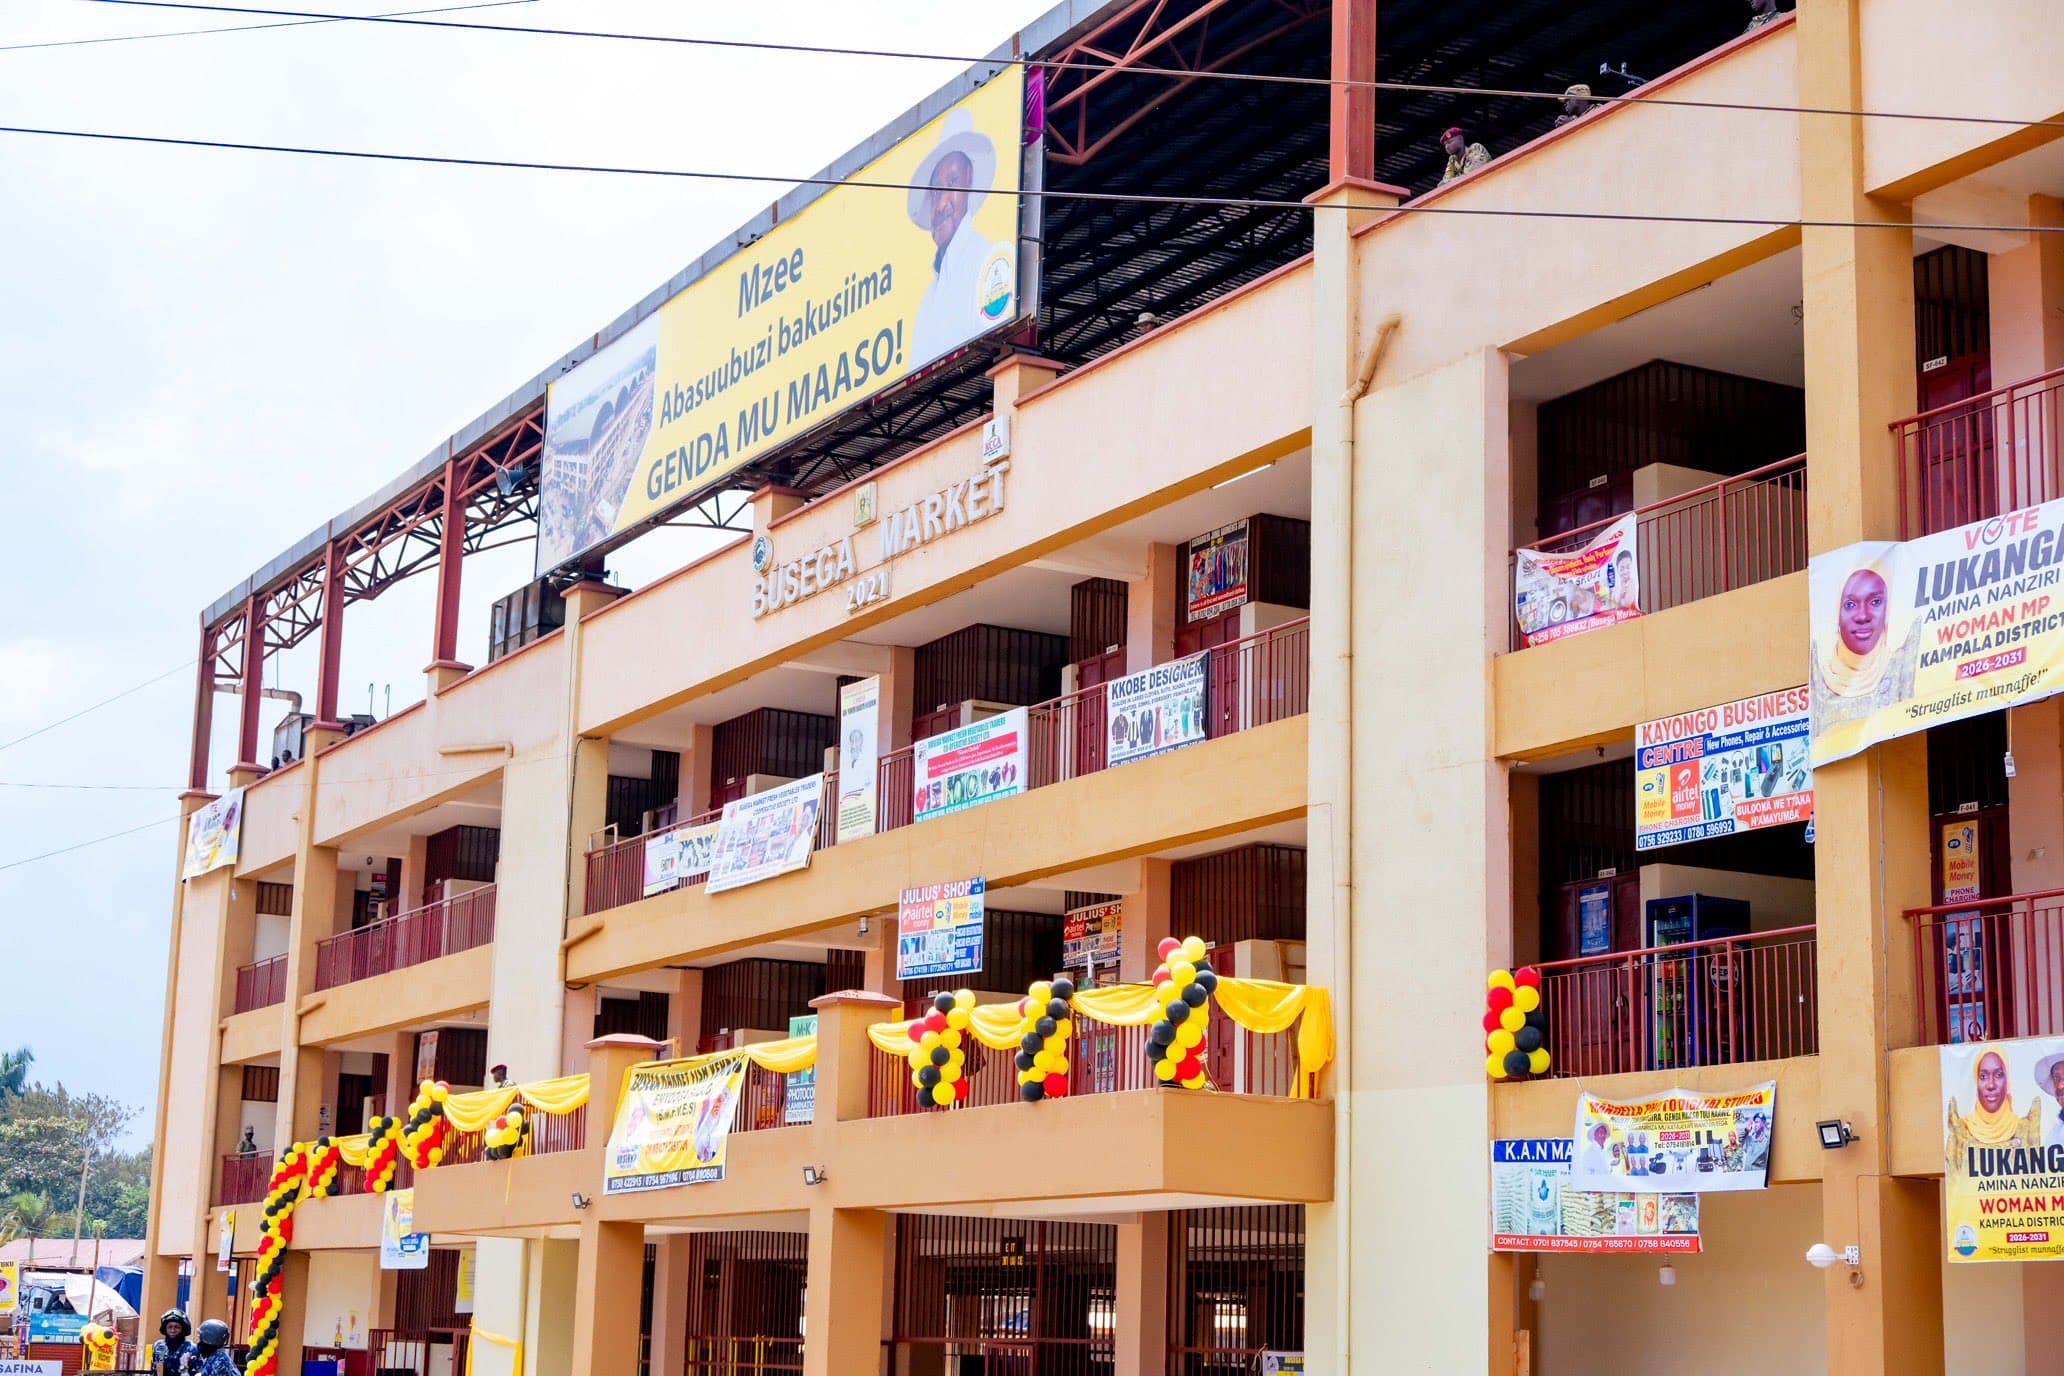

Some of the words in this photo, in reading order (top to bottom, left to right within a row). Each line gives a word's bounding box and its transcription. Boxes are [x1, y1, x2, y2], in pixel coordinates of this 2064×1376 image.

[738, 247, 804, 318] Mzee
[660, 327, 773, 429] Abasuubuzi
[778, 262, 893, 358] bakusiima
[646, 421, 730, 500] GENDA
[736, 390, 779, 452] MU
[786, 319, 904, 426] MAASO!
[752, 535, 856, 620] BUSEGA
[879, 460, 1010, 562] MARKET
[1965, 507, 2041, 551] VOTE
[847, 570, 890, 612] 2021
[1924, 594, 1982, 625] AMINA
[1986, 567, 2060, 605] NANZIRI
[1936, 605, 2016, 646] WOMAN
[2020, 595, 2051, 620] MP
[1919, 634, 1993, 669] KAMPALA
[1961, 651, 2024, 678] 2026-2031
[1111, 674, 1147, 700] KKOBE
[1641, 709, 1719, 747] KAYONGO
[1722, 687, 1810, 729] BUSINESS
[1643, 736, 1704, 769] CENTRE
[1706, 738, 1721, 752] New
[1720, 732, 1744, 750] Phones,
[1744, 728, 1764, 746] Repair
[1765, 726, 1771, 739] &
[1771, 720, 1811, 738] Accessories
[1672, 783, 1699, 804] airtel
[1638, 832, 1656, 848] 0756
[1656, 828, 1683, 845] 929233
[1949, 871, 1976, 881] Money
[1950, 860, 1975, 870] Mobile
[903, 885, 941, 905] JULIUS'
[943, 880, 972, 899] SHOP
[1950, 886, 1975, 896] PHONE
[911, 903, 933, 921] airtel
[1070, 907, 1108, 923] JULIUS'
[1505, 1141, 1548, 1161] K.A.N
[1551, 1141, 1573, 1161] MA
[1968, 1144, 2064, 1178] LUKANG
[1978, 1179, 2017, 1192] AMINA
[2021, 1176, 2064, 1190] NANZI
[1979, 1196, 2047, 1214] WOMAN
[1979, 1217, 2025, 1229] KAMPALA
[1497, 1236, 1532, 1247] CONTACT:
[1533, 1239, 1550, 1247] 0701
[1583, 1240, 1602, 1248] 0754
[2008, 1233, 2048, 1242] 2026-2031
[0, 1364, 43, 1374] SAFINA
